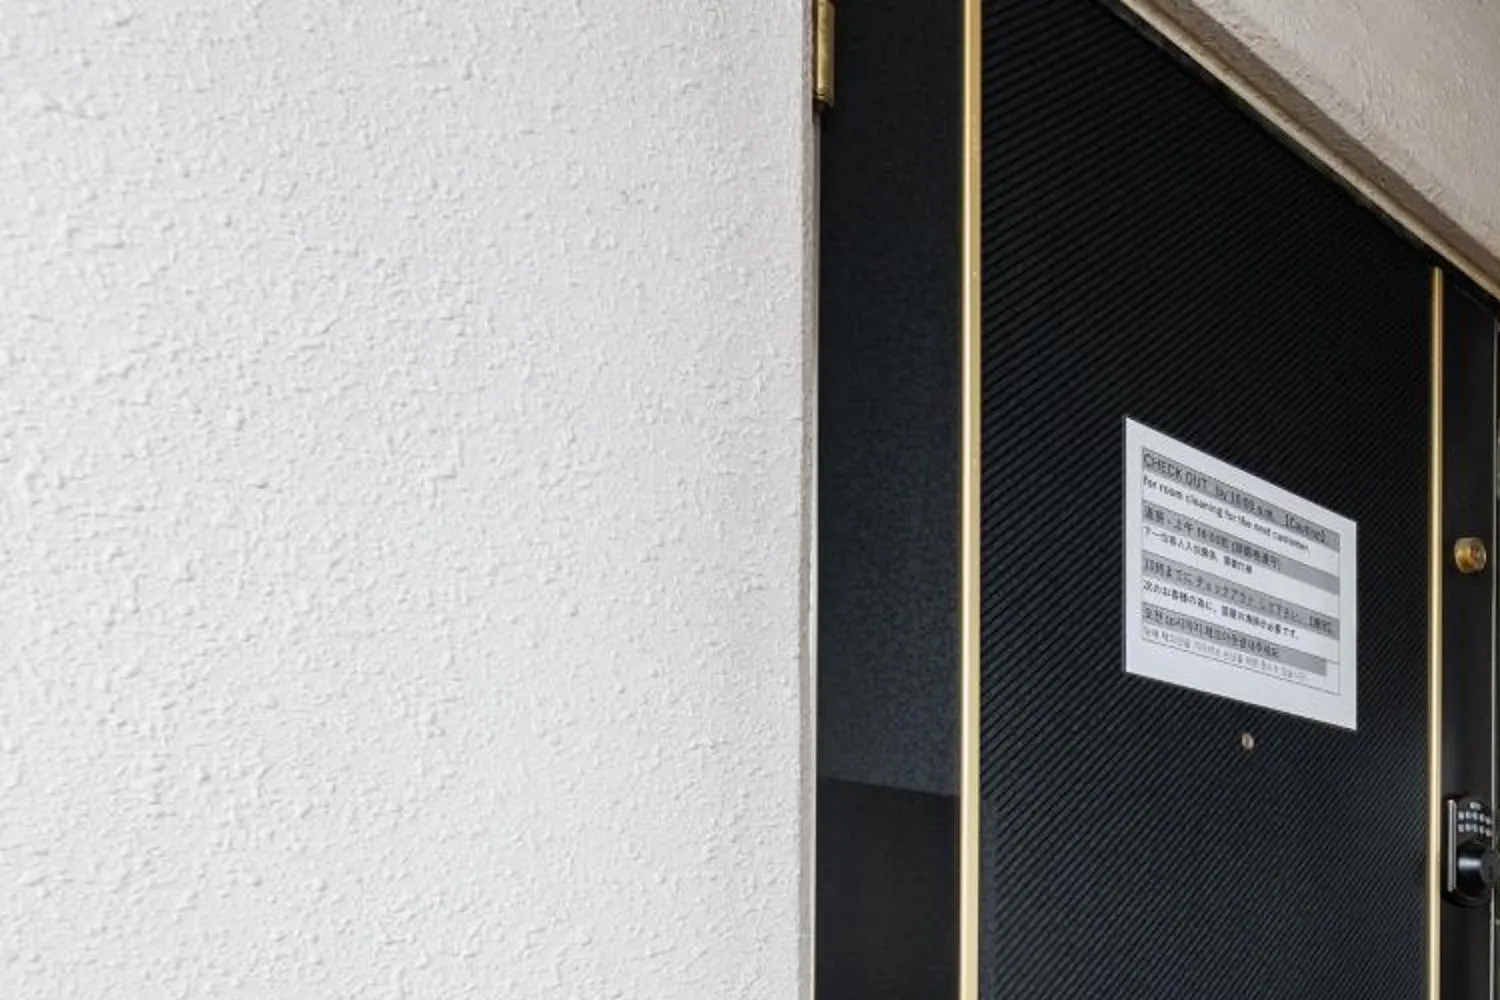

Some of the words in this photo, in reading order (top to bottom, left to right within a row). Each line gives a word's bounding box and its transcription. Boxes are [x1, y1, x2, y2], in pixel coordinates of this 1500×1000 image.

[1143, 452, 1183, 481] CHECK
[1185, 470, 1207, 491] OUT
[1159, 481, 1182, 500] room
[1184, 491, 1223, 520] cleaning
